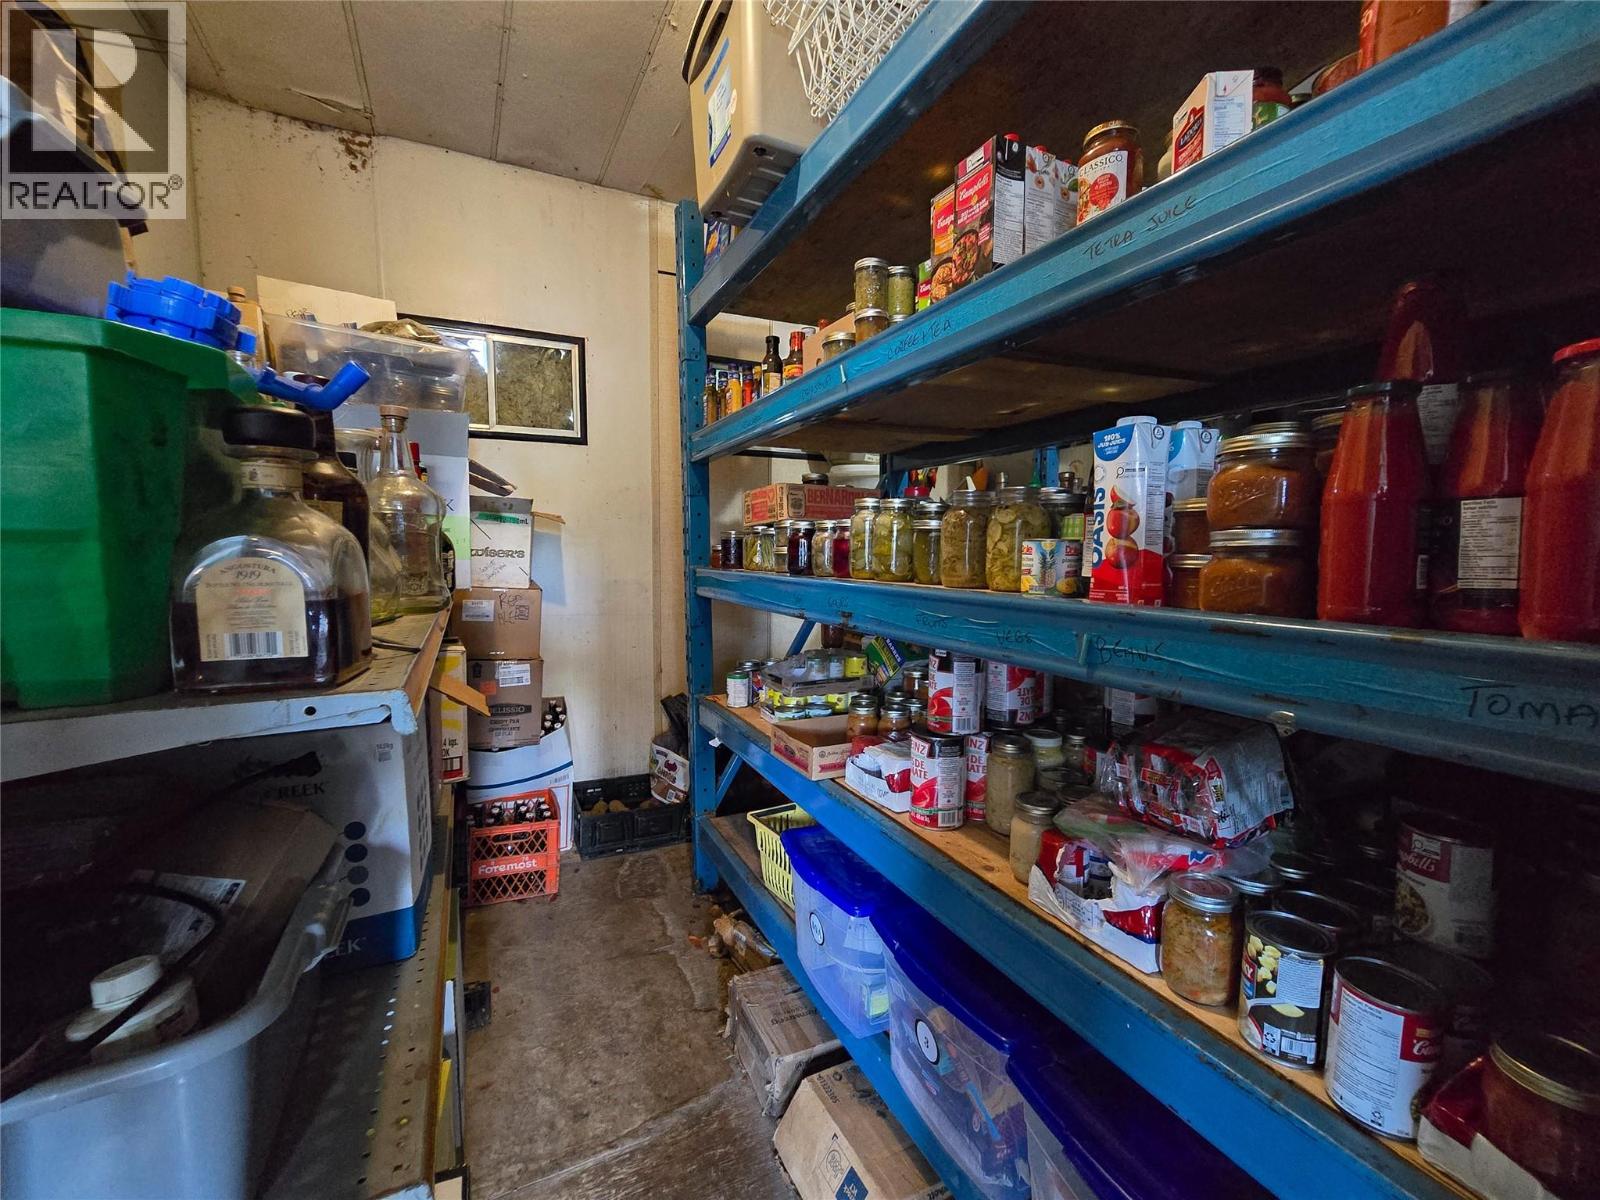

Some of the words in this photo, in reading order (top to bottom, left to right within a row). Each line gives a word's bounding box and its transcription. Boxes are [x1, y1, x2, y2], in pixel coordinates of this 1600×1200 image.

[1079, 153, 1123, 177] CLASSICO
[1084, 229, 1136, 261] TETRA
[1147, 196, 1198, 231] JUICE
[1092, 486, 1106, 569] OASIS
[236, 569, 261, 580] 1919
[1018, 711, 1032, 722] INZ
[912, 740, 927, 755] INZ
[967, 738, 984, 750] INZ
[915, 758, 925, 769] DE
[970, 755, 984, 765] DE
[912, 768, 929, 780] ATE
[967, 763, 987, 774] ATE
[478, 858, 538, 876] Foremost
